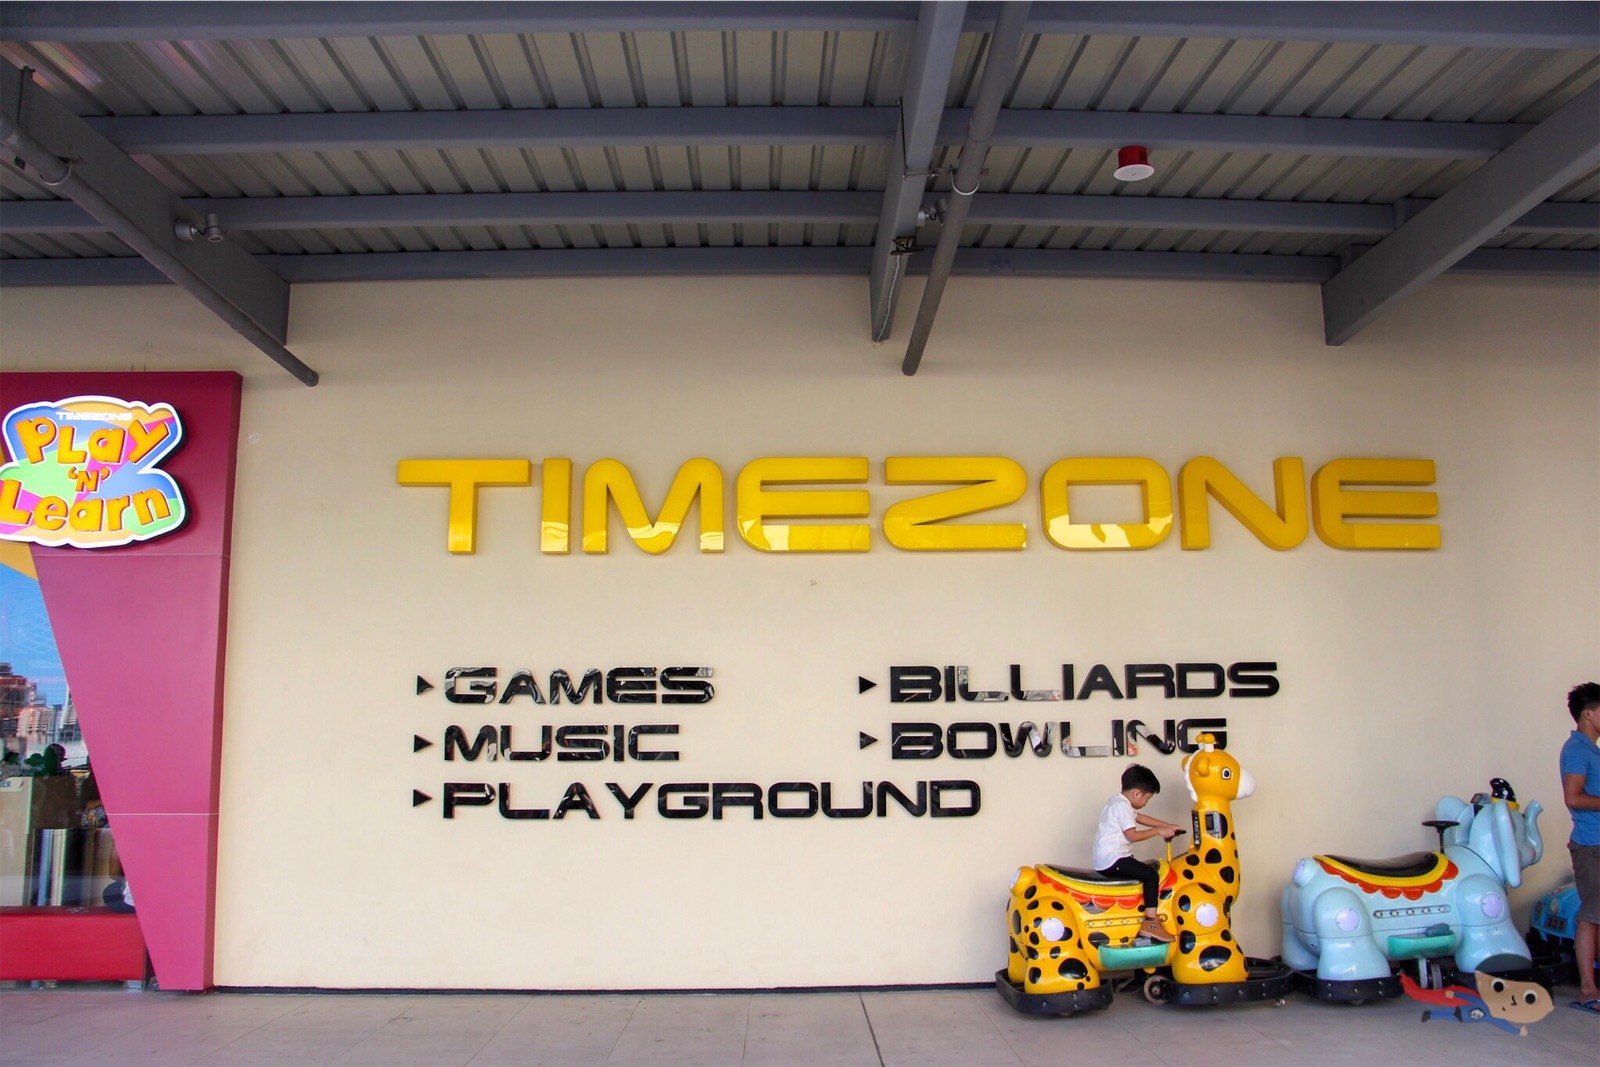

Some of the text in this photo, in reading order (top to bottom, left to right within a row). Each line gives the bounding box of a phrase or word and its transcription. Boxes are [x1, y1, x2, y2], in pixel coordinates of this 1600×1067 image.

[0, 479, 171, 532] Learn
[397, 456, 1442, 556] TIMEZONE
[444, 666, 715, 705] GAMES
[890, 661, 1280, 703] BILLIARDS
[443, 724, 680, 762] MUSIC
[891, 717, 1227, 760] BOWLING
[442, 780, 982, 820] PLAYGROUND
